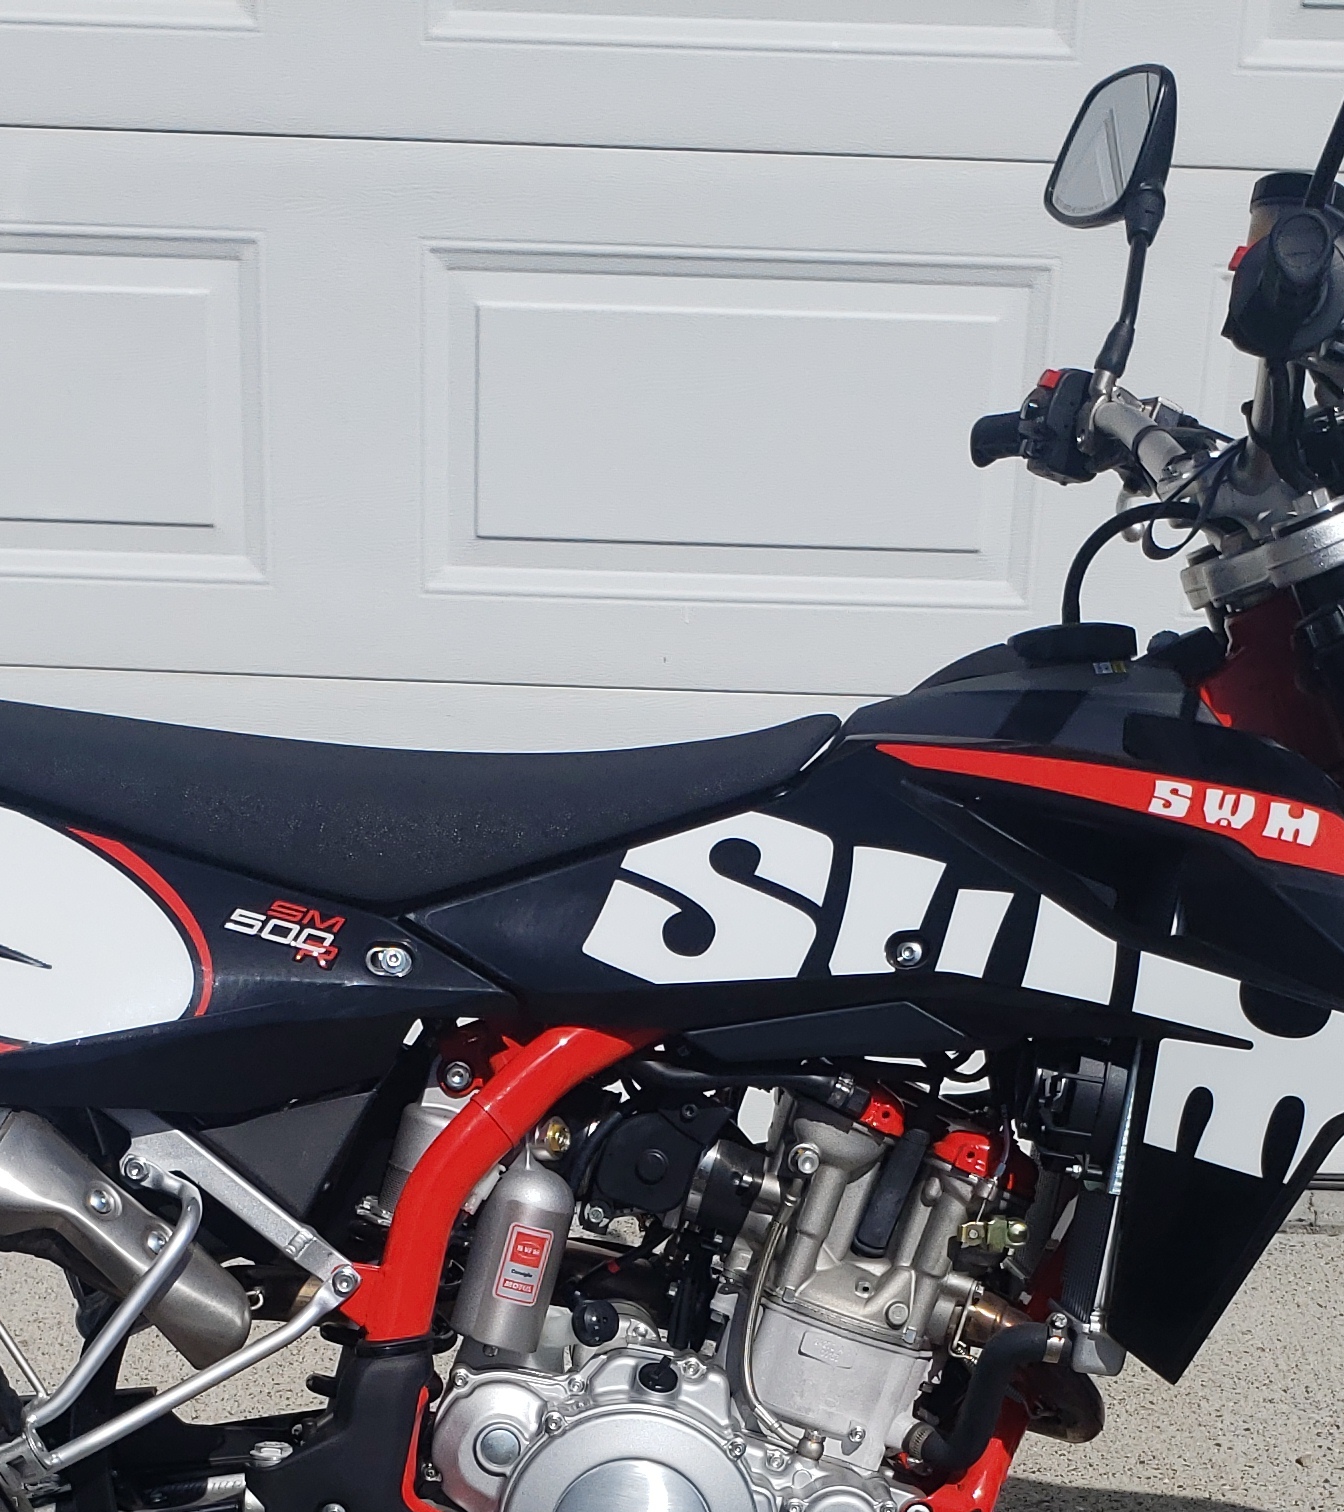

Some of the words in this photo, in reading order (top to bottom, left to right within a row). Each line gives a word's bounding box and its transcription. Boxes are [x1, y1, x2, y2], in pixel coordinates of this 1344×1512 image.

[1147, 779, 1320, 847] SWM
[223, 908, 335, 954] 500
[266, 899, 346, 934] SM
[294, 939, 339, 969] R
